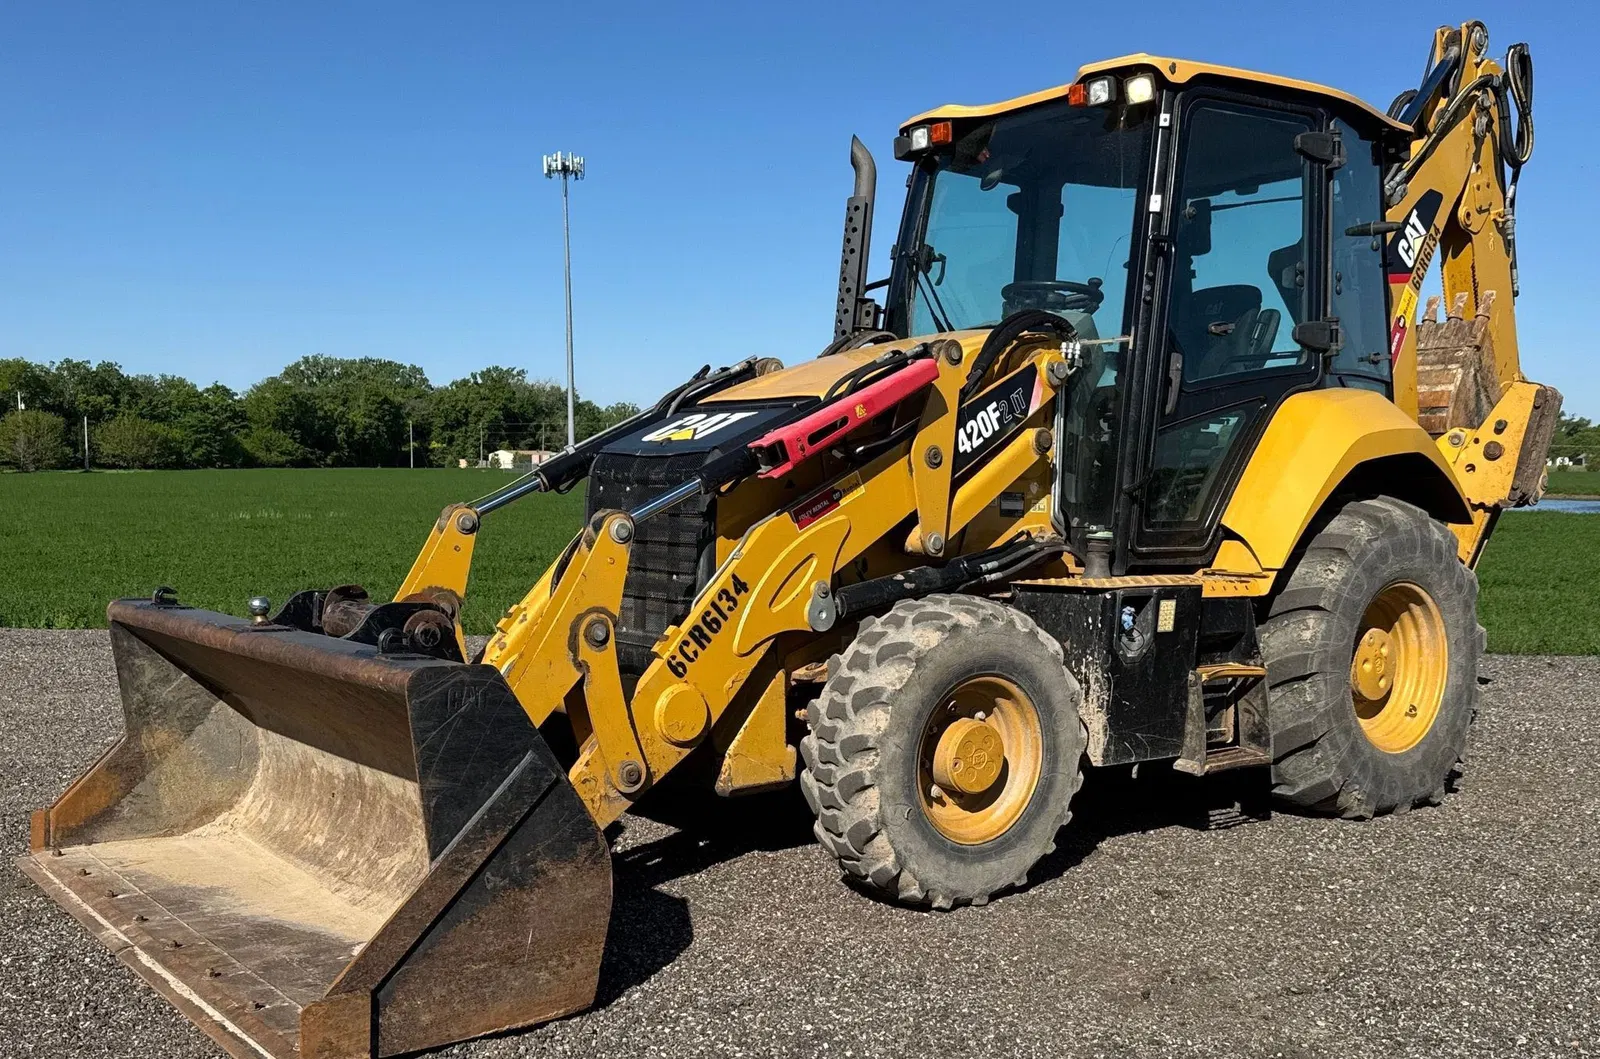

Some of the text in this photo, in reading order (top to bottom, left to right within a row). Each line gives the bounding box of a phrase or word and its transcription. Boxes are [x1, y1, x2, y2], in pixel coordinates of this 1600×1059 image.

[1398, 208, 1427, 268] CAT
[1411, 222, 1441, 291] 6CR6134
[1010, 387, 1027, 414] IT
[641, 411, 759, 441] CAT
[798, 509, 813, 520] FOLEY
[812, 499, 830, 513] RENTAL
[666, 572, 750, 679] 6CR6134
